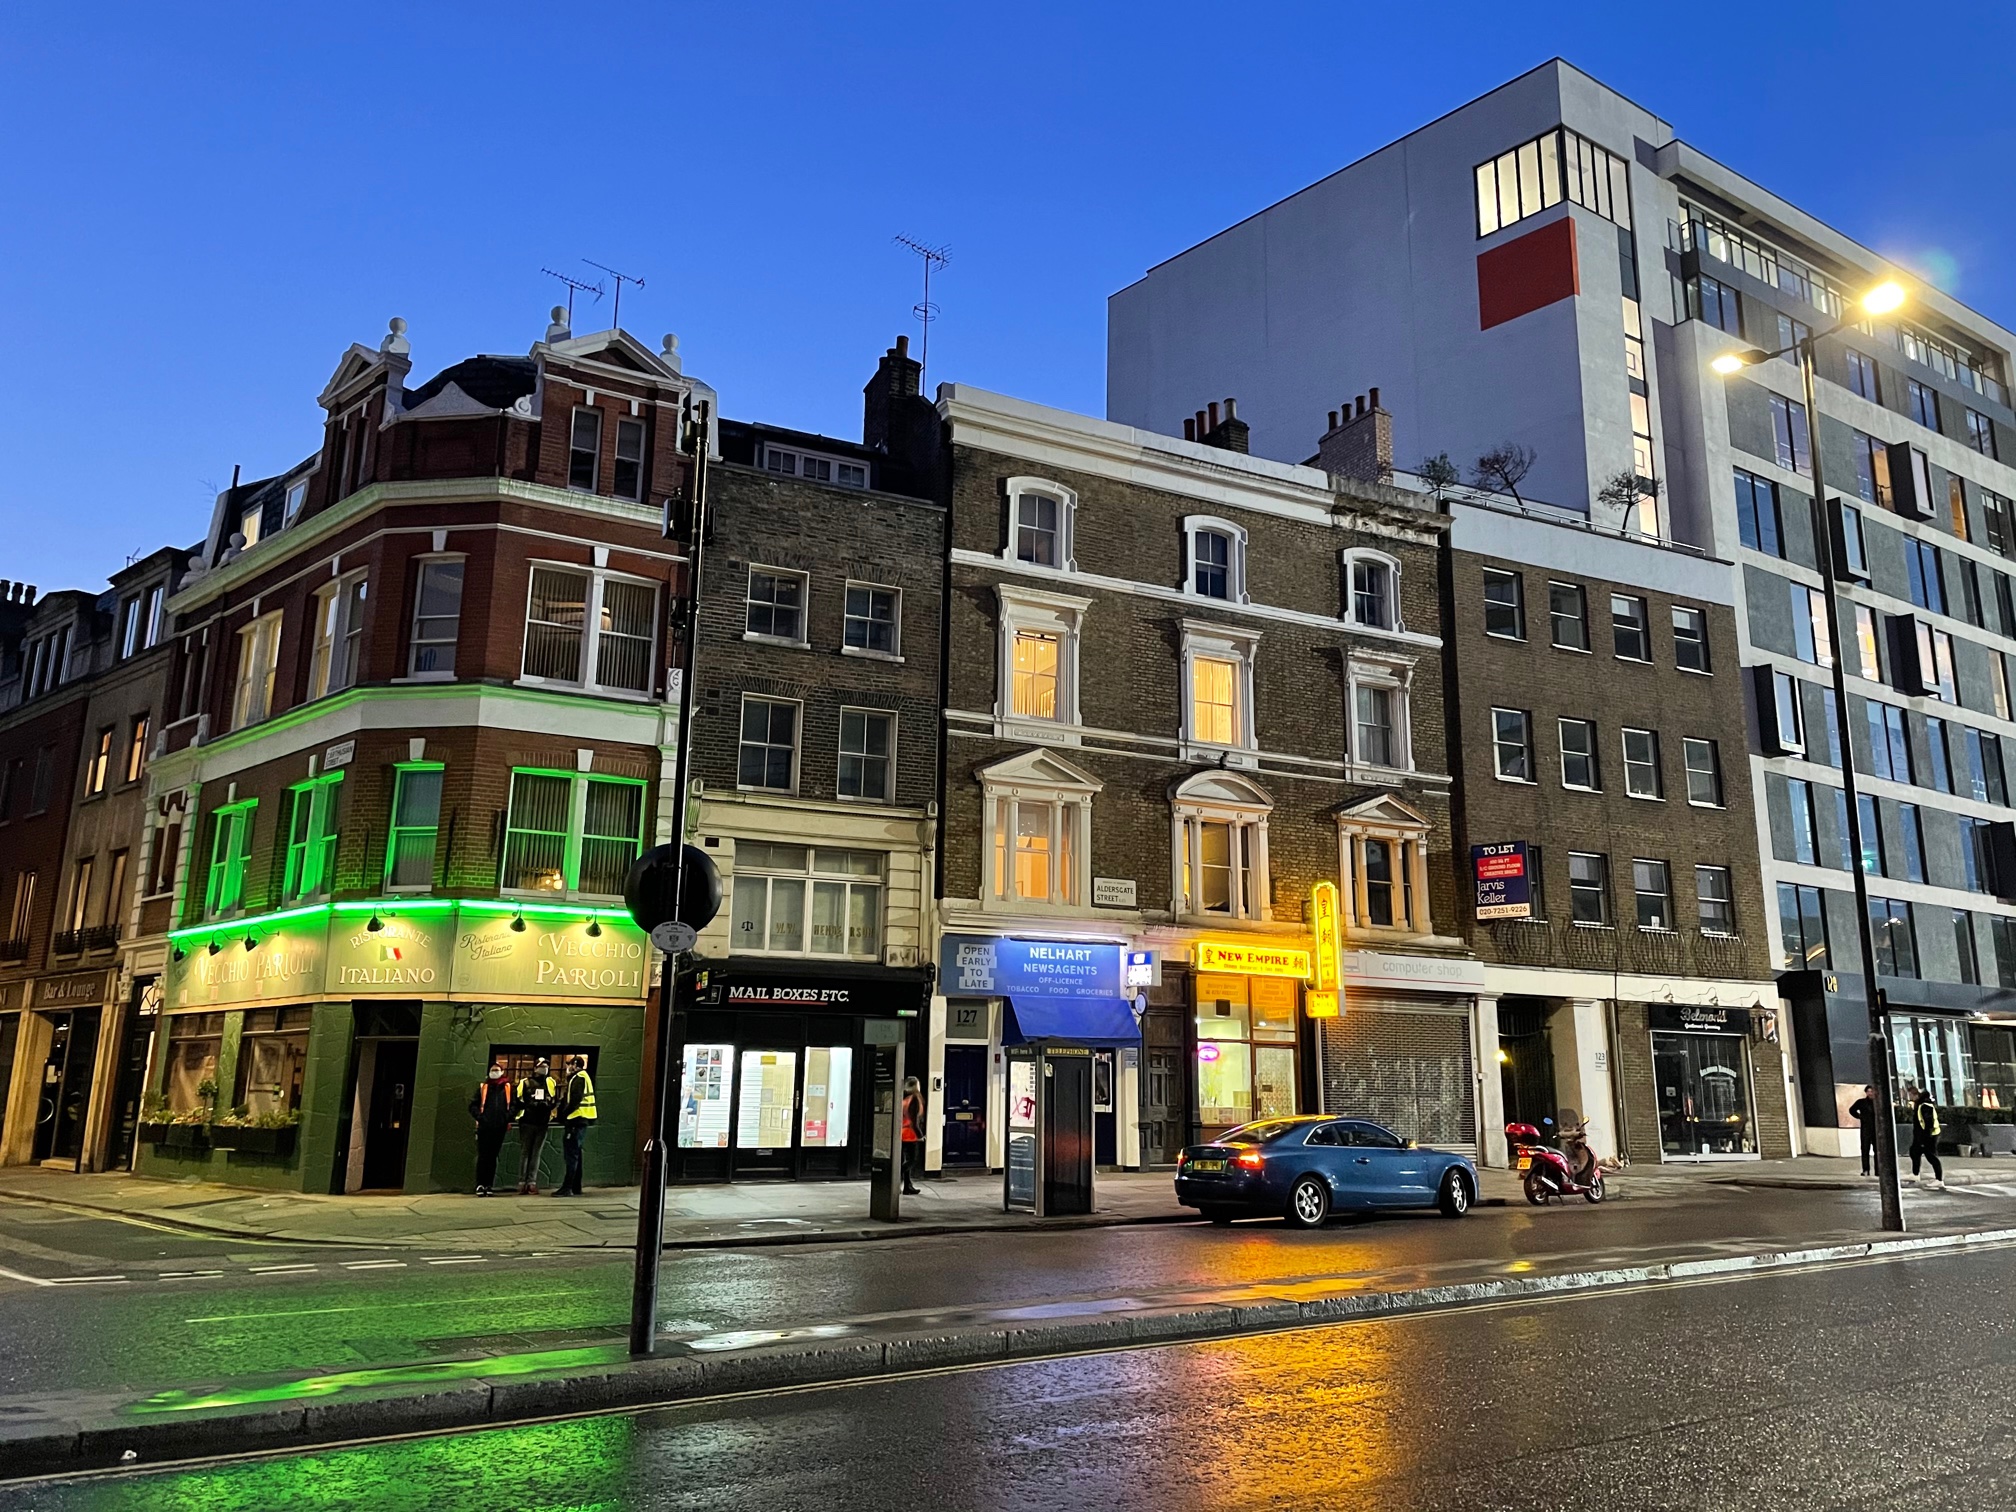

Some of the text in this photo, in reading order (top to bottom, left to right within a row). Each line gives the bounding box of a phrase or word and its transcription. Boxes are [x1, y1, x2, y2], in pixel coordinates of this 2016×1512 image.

[1483, 845, 1515, 856] TO LET
[1096, 885, 1134, 895] ALDERSGATE
[1477, 879, 1505, 893] Jarvis
[1096, 894, 1119, 902] STREET
[1477, 892, 1506, 904] Keller
[1479, 905, 1528, 915] 020-7251-9226
[350, 925, 432, 949] RISTORANTE
[471, 944, 513, 960] Italiano
[538, 932, 642, 959] VECCHIO
[963, 946, 990, 956] OPEN
[1029, 946, 1092, 961] NELHART
[1218, 950, 1290, 967] NEW EMPIRE
[194, 955, 249, 986] VECCHIO
[255, 949, 314, 981] PARIOLI
[961, 956, 991, 966] EARLY
[339, 965, 436, 985] ITALIANO
[536, 960, 640, 990] PARIOLI
[970, 968, 983, 977] TO
[1023, 962, 1098, 976] NEWSAGENTS
[1382, 961, 1463, 977] computer shop
[964, 979, 988, 989] LATE
[1038, 976, 1083, 985] OFF-LICENCE
[43, 980, 96, 1002] Bar & Lounge
[728, 986, 769, 999] MAIL
[772, 987, 818, 1001] BOXES
[819, 989, 850, 1002] ETC.
[1006, 985, 1040, 993] TOBACCO
[1076, 988, 1114, 996] GROCERIES
[957, 1009, 978, 1023] 127
[1051, 1048, 1085, 1056] TELEPHONE
[1595, 1052, 1605, 1061] 123
